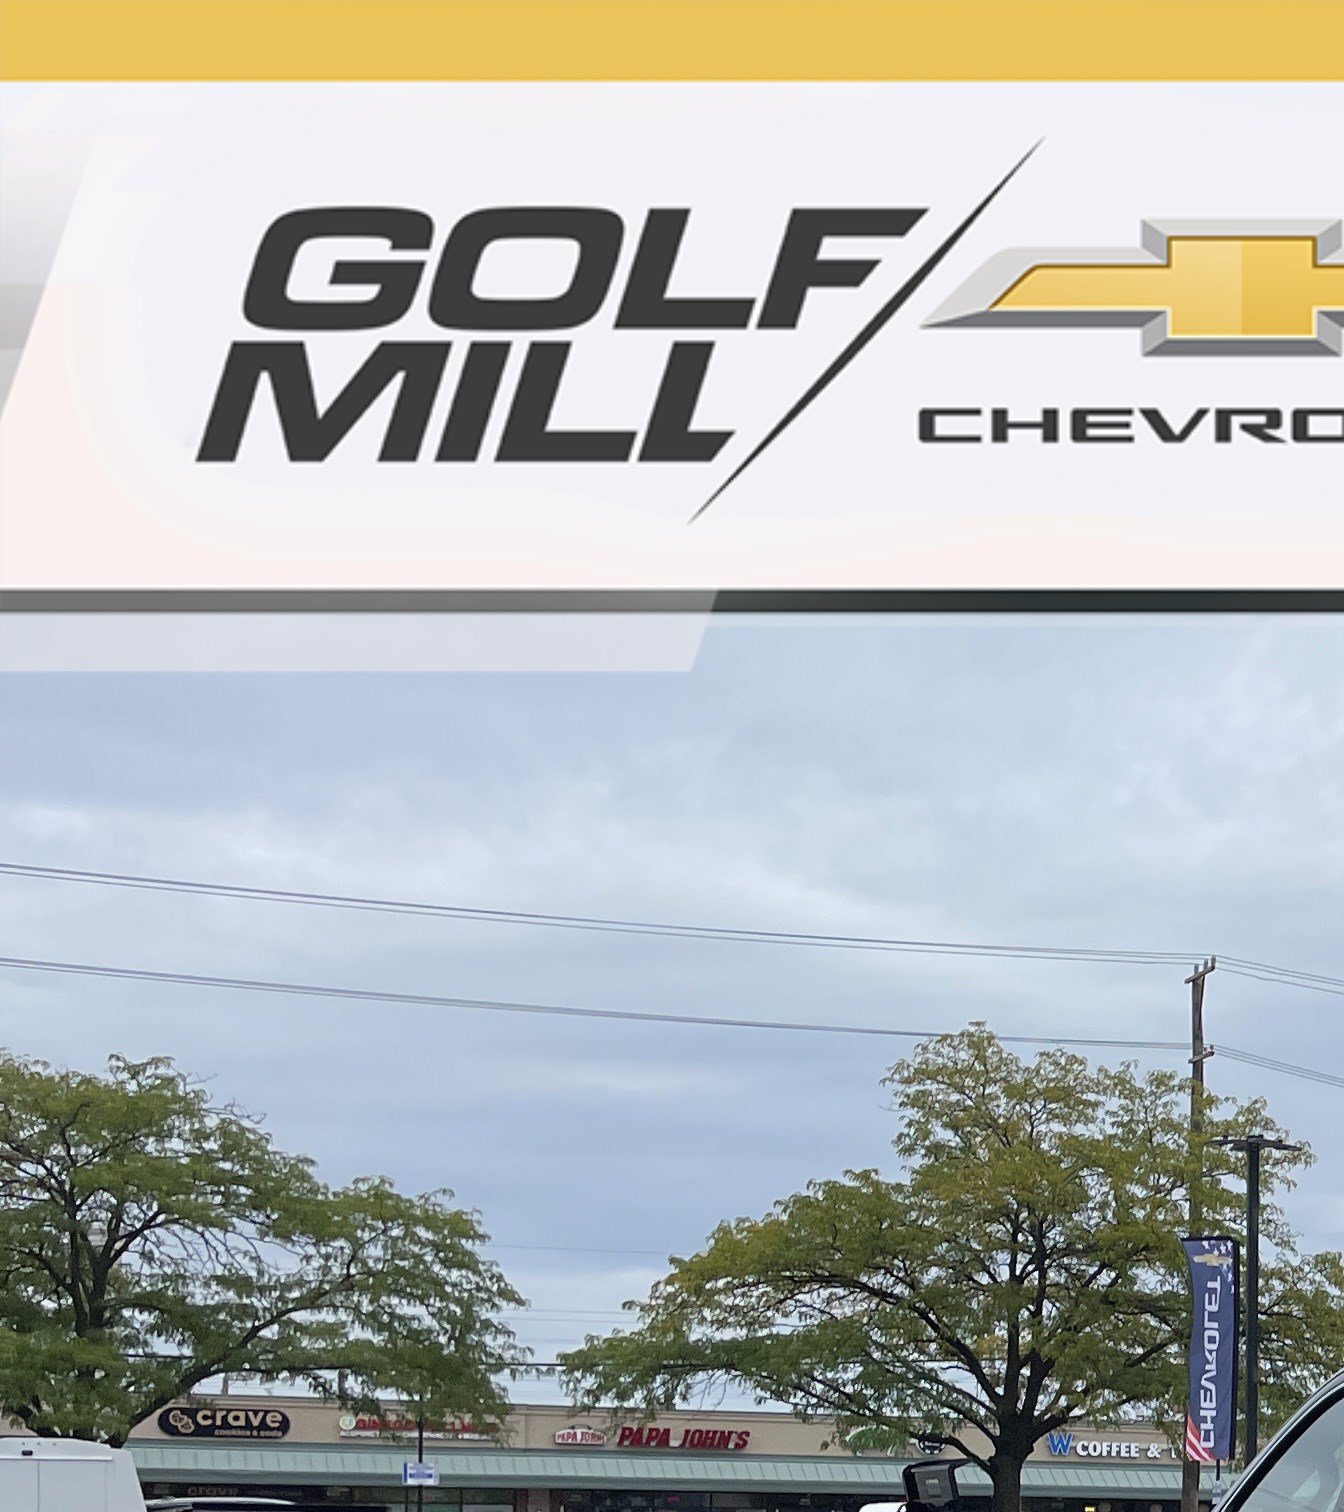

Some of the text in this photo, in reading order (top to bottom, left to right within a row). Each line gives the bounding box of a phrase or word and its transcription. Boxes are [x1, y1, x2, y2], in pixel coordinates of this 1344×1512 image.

[196, 1409, 282, 1428] crave
[617, 1427, 750, 1449] PAPA JOHN'S
[1047, 1432, 1074, 1457] W
[1076, 1441, 1141, 1459] COFFEE
[1146, 1443, 1162, 1459] &
